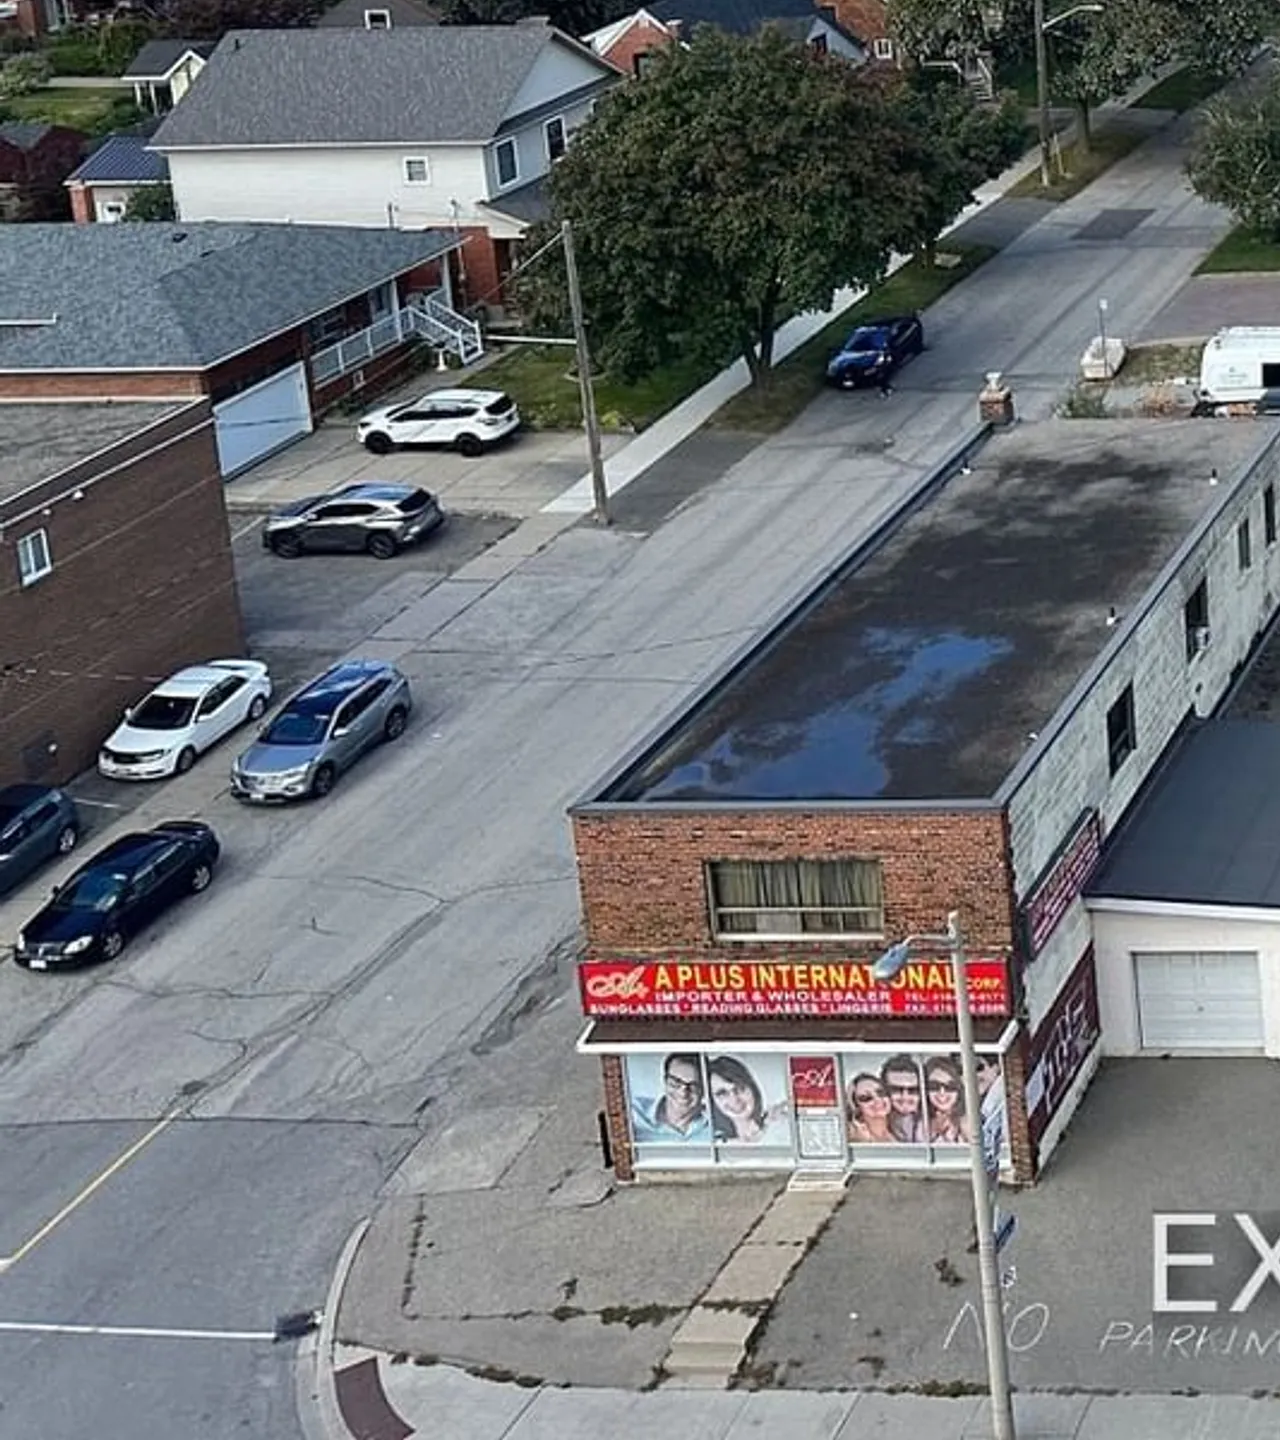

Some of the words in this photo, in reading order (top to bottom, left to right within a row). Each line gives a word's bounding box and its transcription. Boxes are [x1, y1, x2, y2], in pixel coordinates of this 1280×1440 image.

[655, 964, 673, 990] A
[677, 964, 745, 990] PLUS
[753, 964, 956, 990] INTERNATONAL
[655, 991, 749, 1002] IMPORTER
[751, 991, 764, 1002] &
[768, 991, 891, 1002] WHOLESALER
[589, 1003, 678, 1014] SUNGLASSES
[691, 1003, 752, 1014] READING
[755, 1003, 819, 1014] GLASSES
